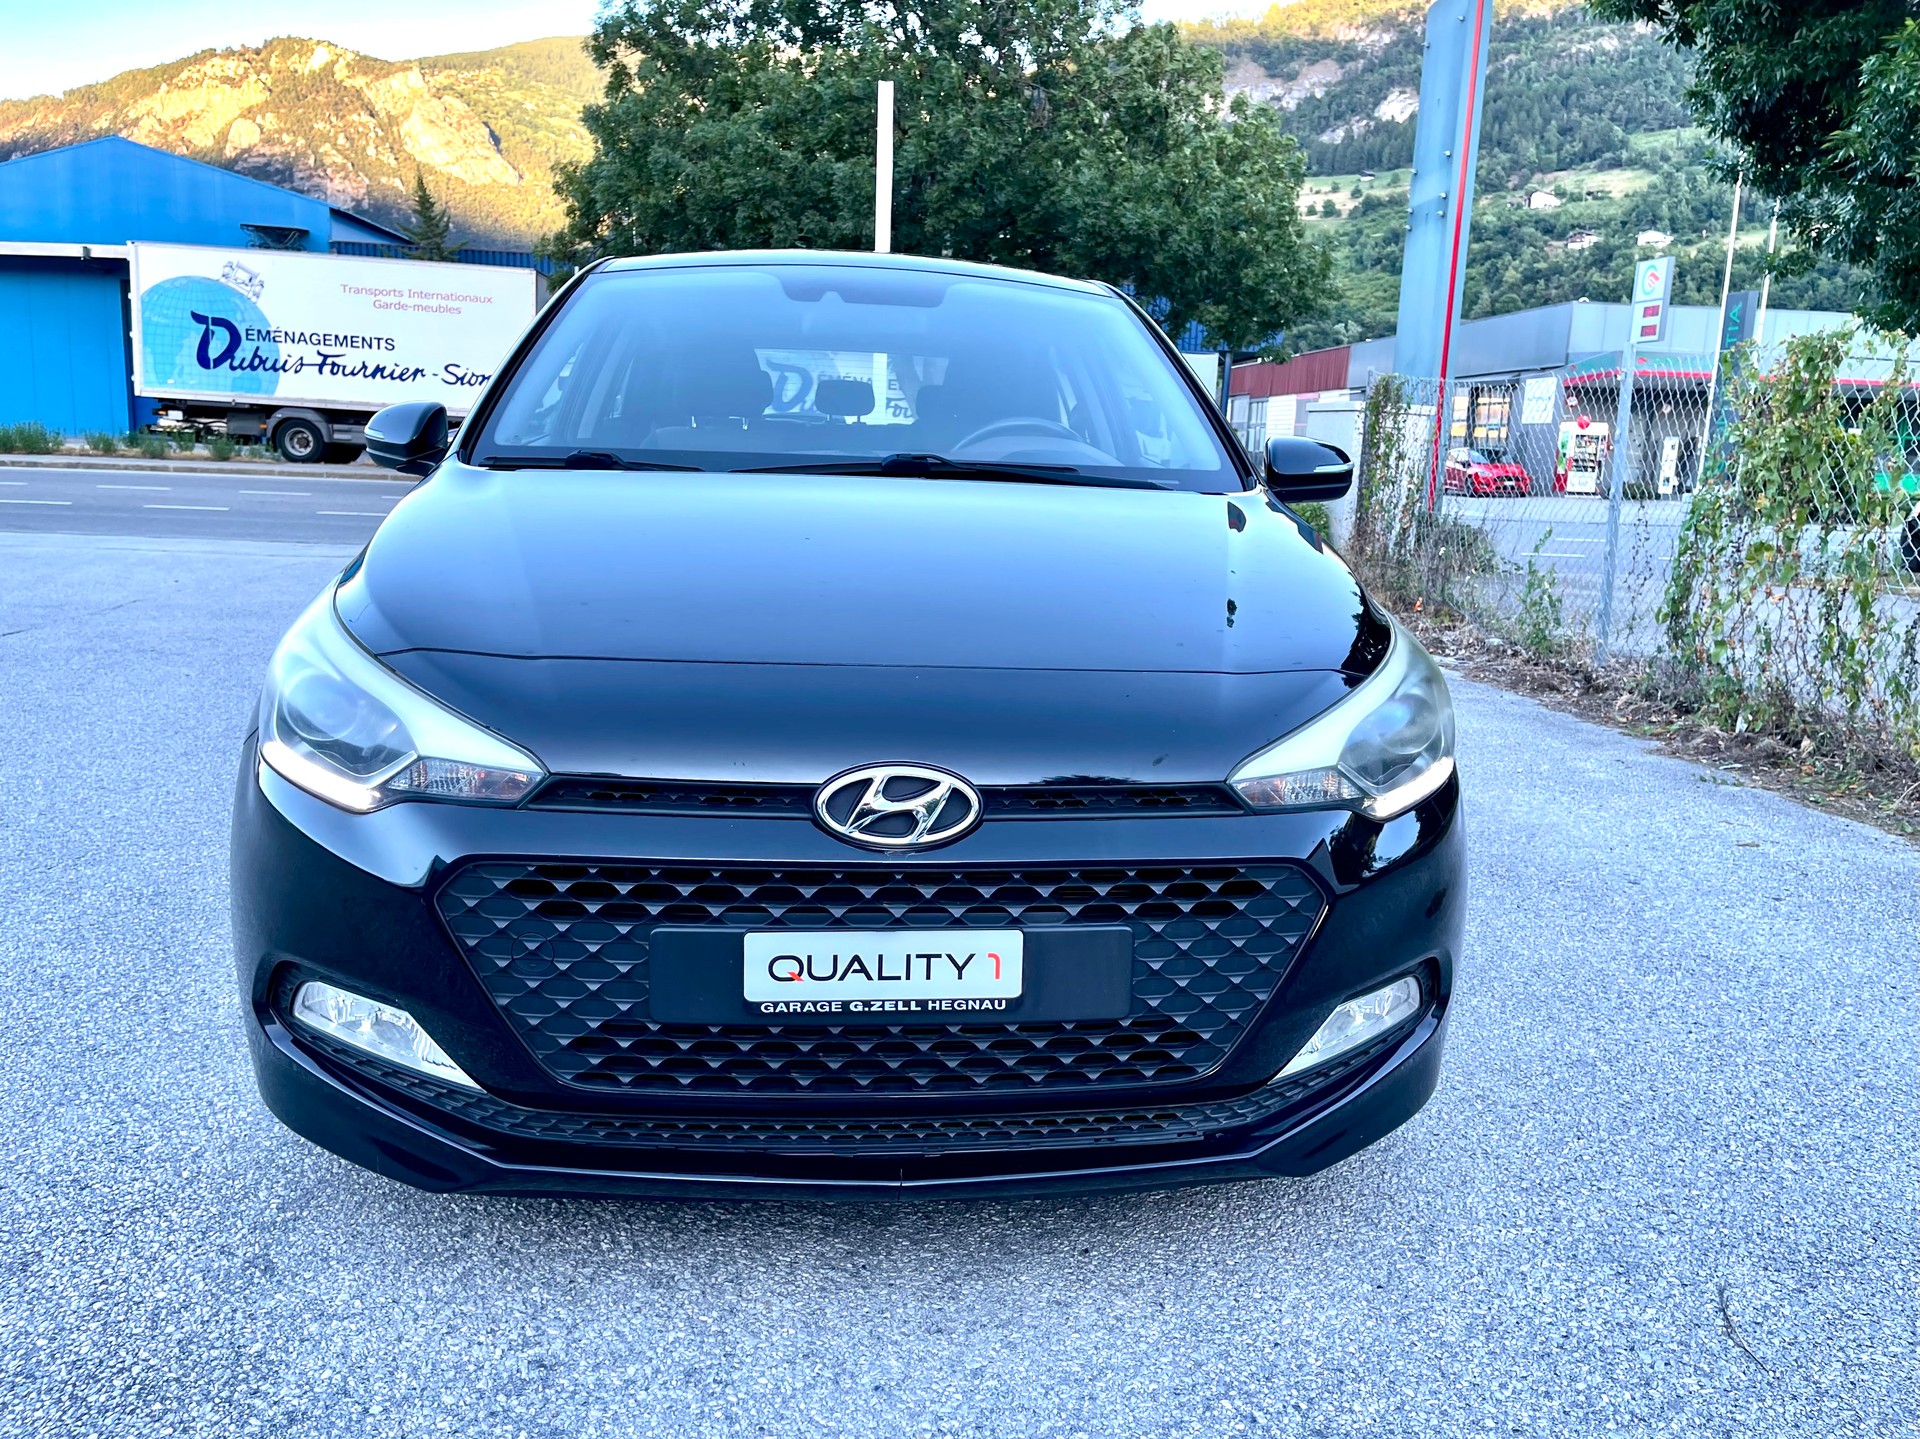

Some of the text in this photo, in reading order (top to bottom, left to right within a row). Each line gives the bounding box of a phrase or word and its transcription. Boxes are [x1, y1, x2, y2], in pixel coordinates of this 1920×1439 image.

[340, 284, 493, 304] Transports Internationaux
[373, 299, 462, 315] Garde-meubles
[767, 952, 1001, 982] QUALITY 1
[760, 999, 1006, 1013] GARAGE G.ZELL HEGNAU
